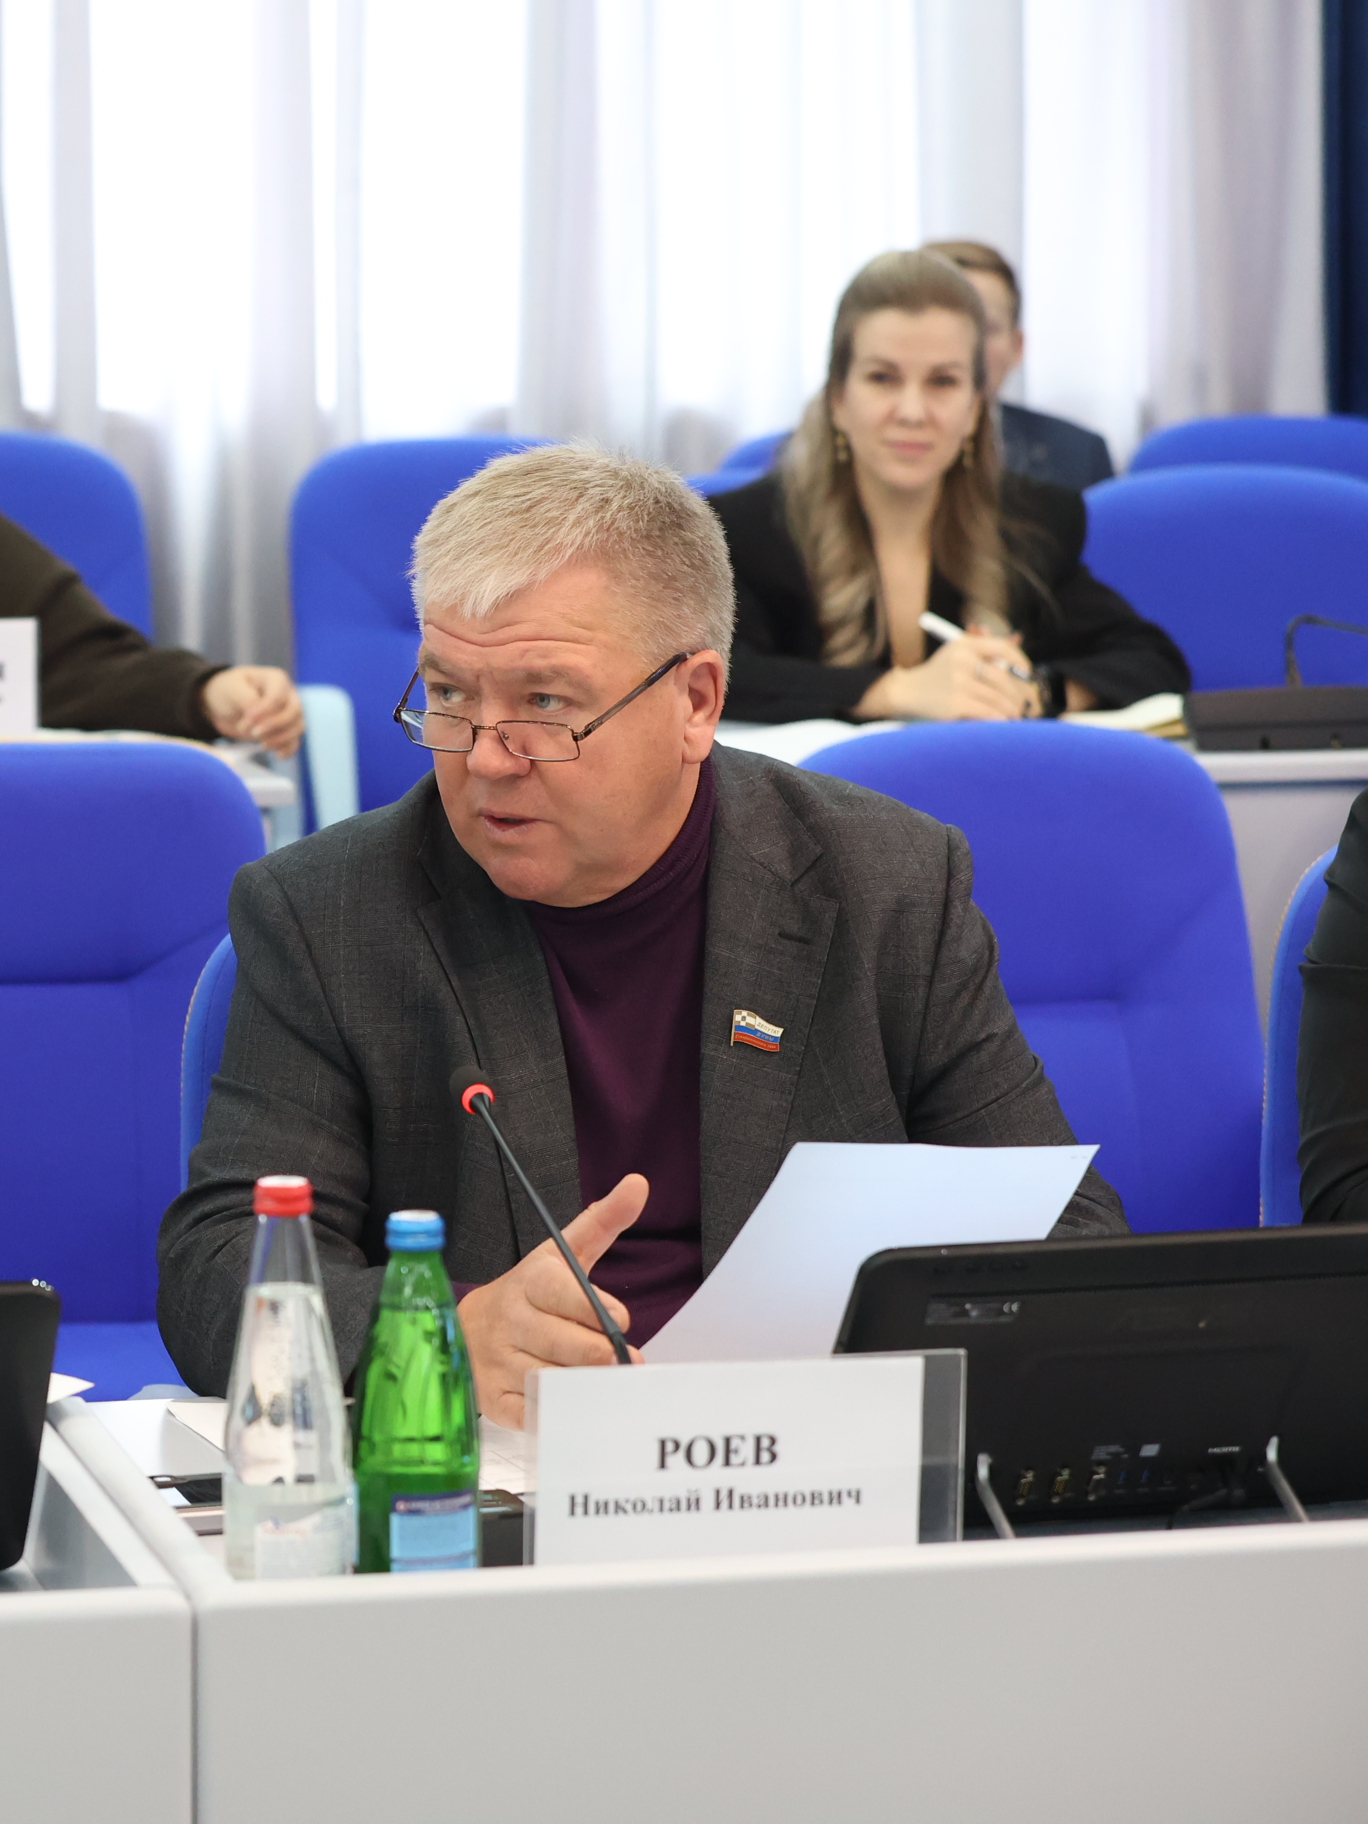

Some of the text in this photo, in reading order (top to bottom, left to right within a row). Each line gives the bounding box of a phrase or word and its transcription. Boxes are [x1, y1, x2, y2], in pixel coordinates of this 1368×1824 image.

[656, 1433, 779, 1470] РОЕВ
[568, 1485, 863, 1518] Николай Иванович
